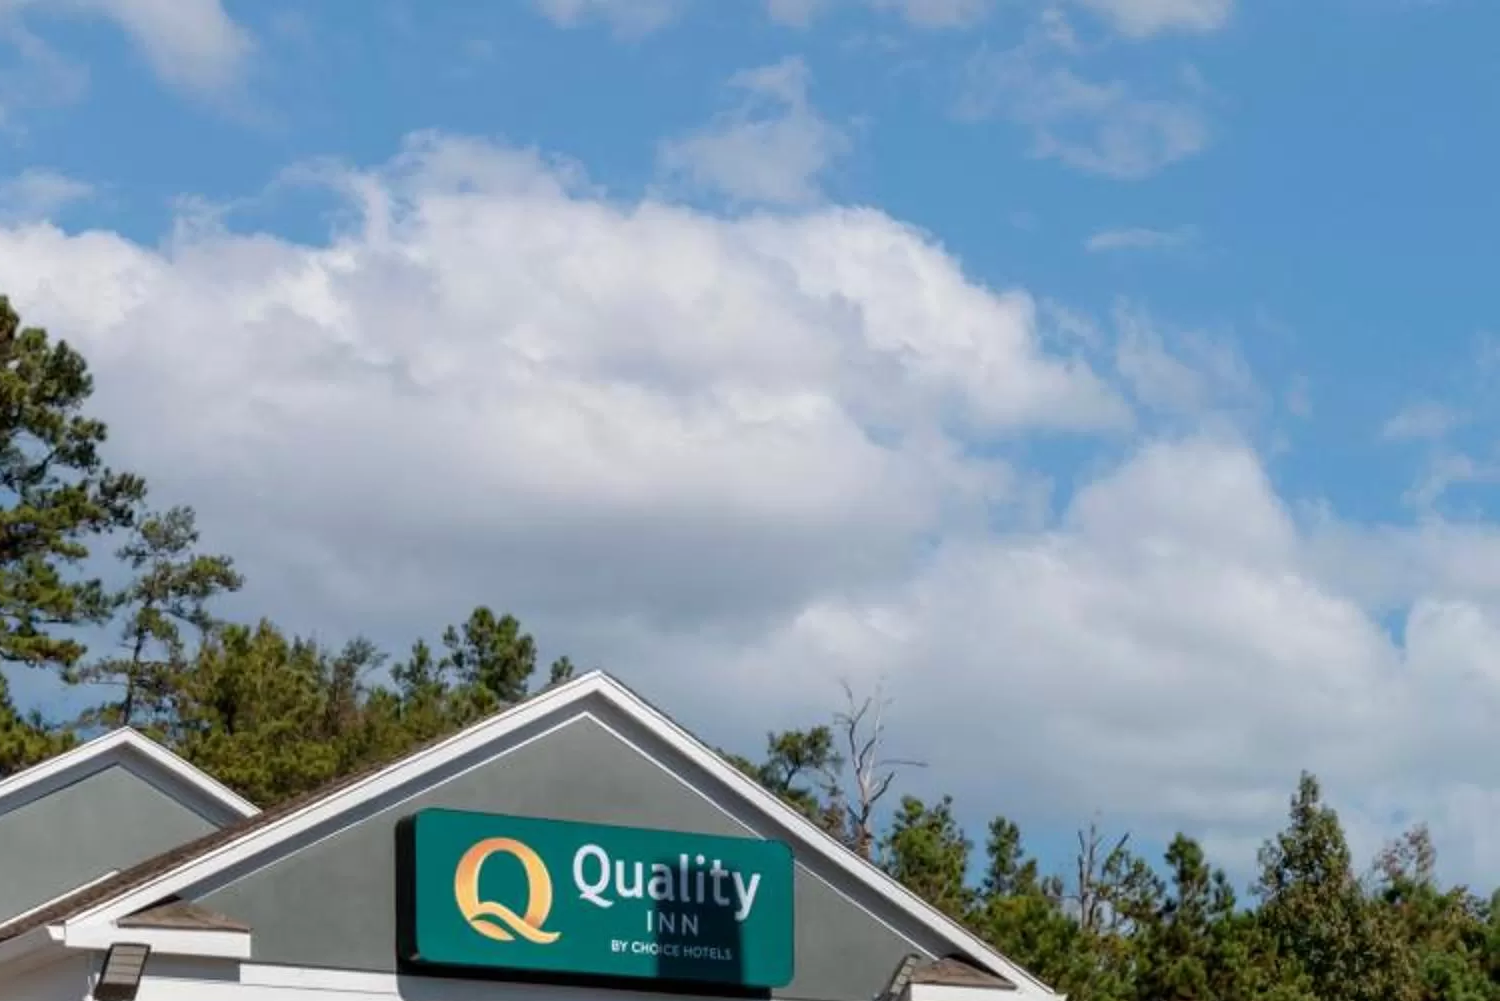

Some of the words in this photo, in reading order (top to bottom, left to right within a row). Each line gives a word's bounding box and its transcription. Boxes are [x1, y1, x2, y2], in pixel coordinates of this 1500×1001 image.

[453, 836, 561, 944] Q
[572, 843, 762, 921] Quality
[646, 909, 699, 937] INN
[610, 939, 628, 953] BY
[631, 941, 680, 957] CHOICE
[683, 946, 733, 961] HOTELS
